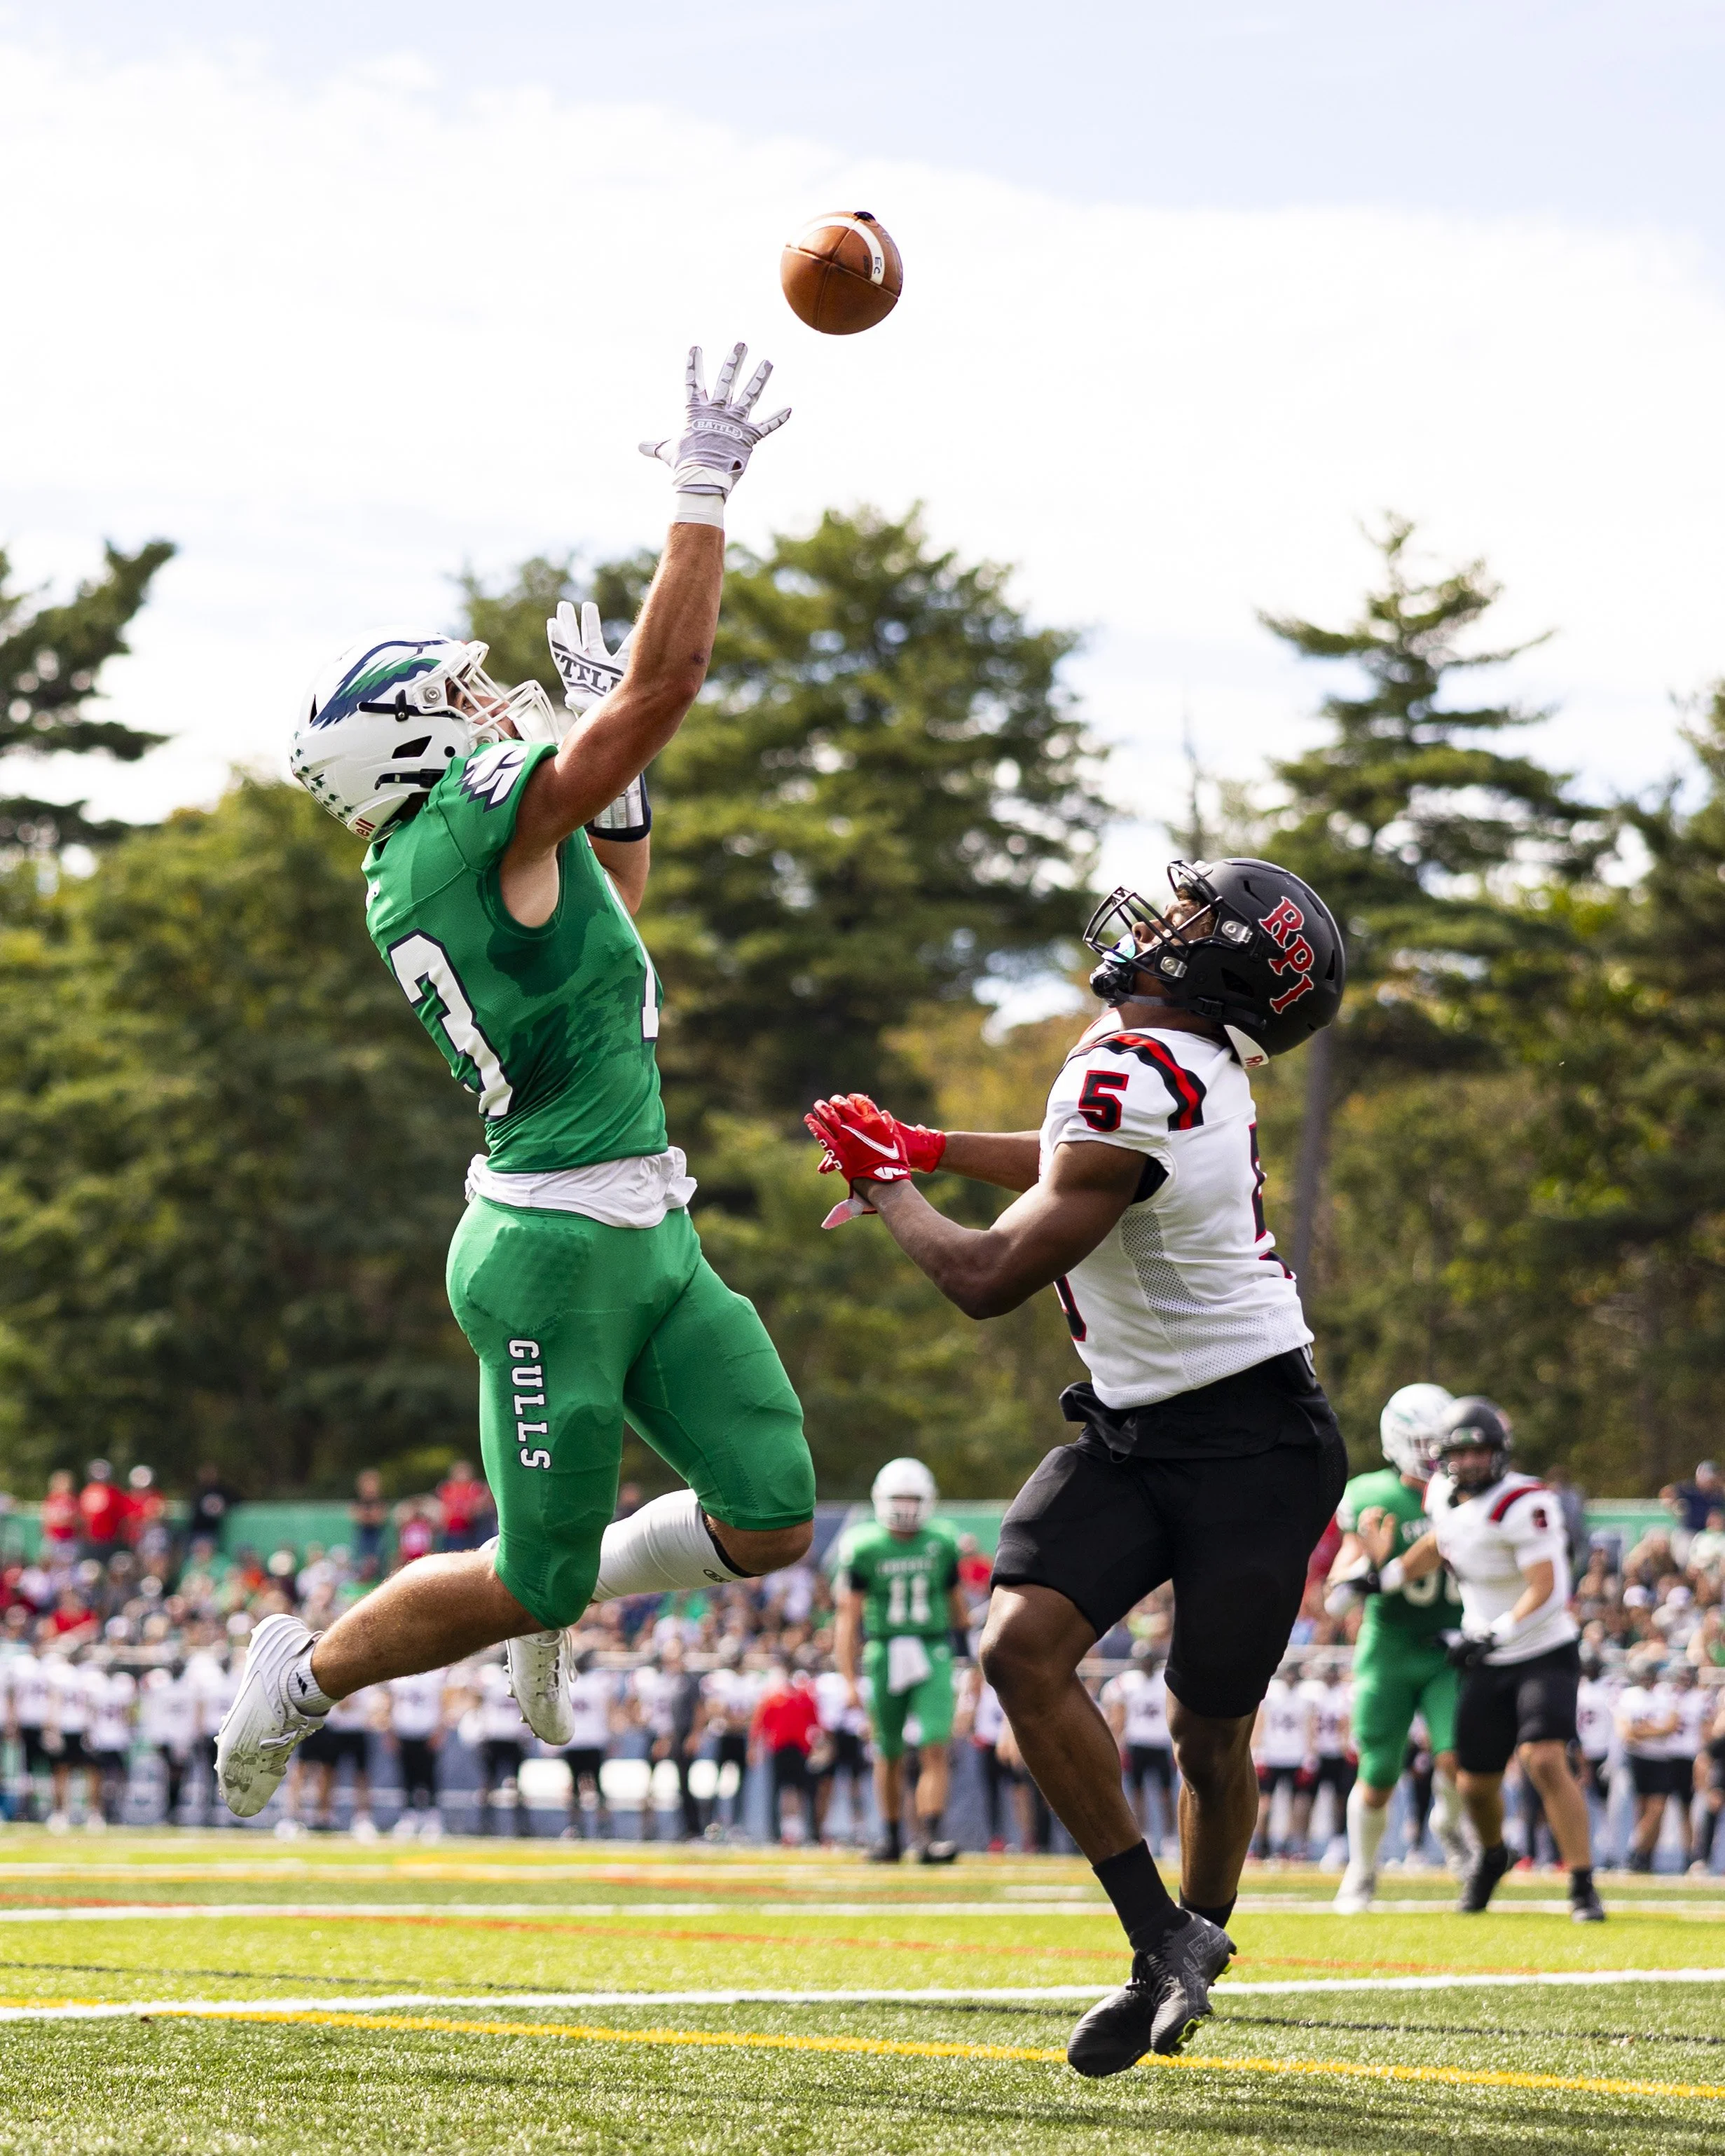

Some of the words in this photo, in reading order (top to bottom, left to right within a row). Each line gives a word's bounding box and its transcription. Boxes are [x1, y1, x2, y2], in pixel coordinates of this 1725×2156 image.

[696, 420, 739, 436] BATTLE
[554, 651, 621, 693] TTL
[1258, 896, 1315, 1015] RPI
[387, 928, 516, 1122] 3
[1078, 1070, 1129, 1132] 5
[507, 1338, 552, 1471] GULLS
[887, 1574, 932, 1625] 11
